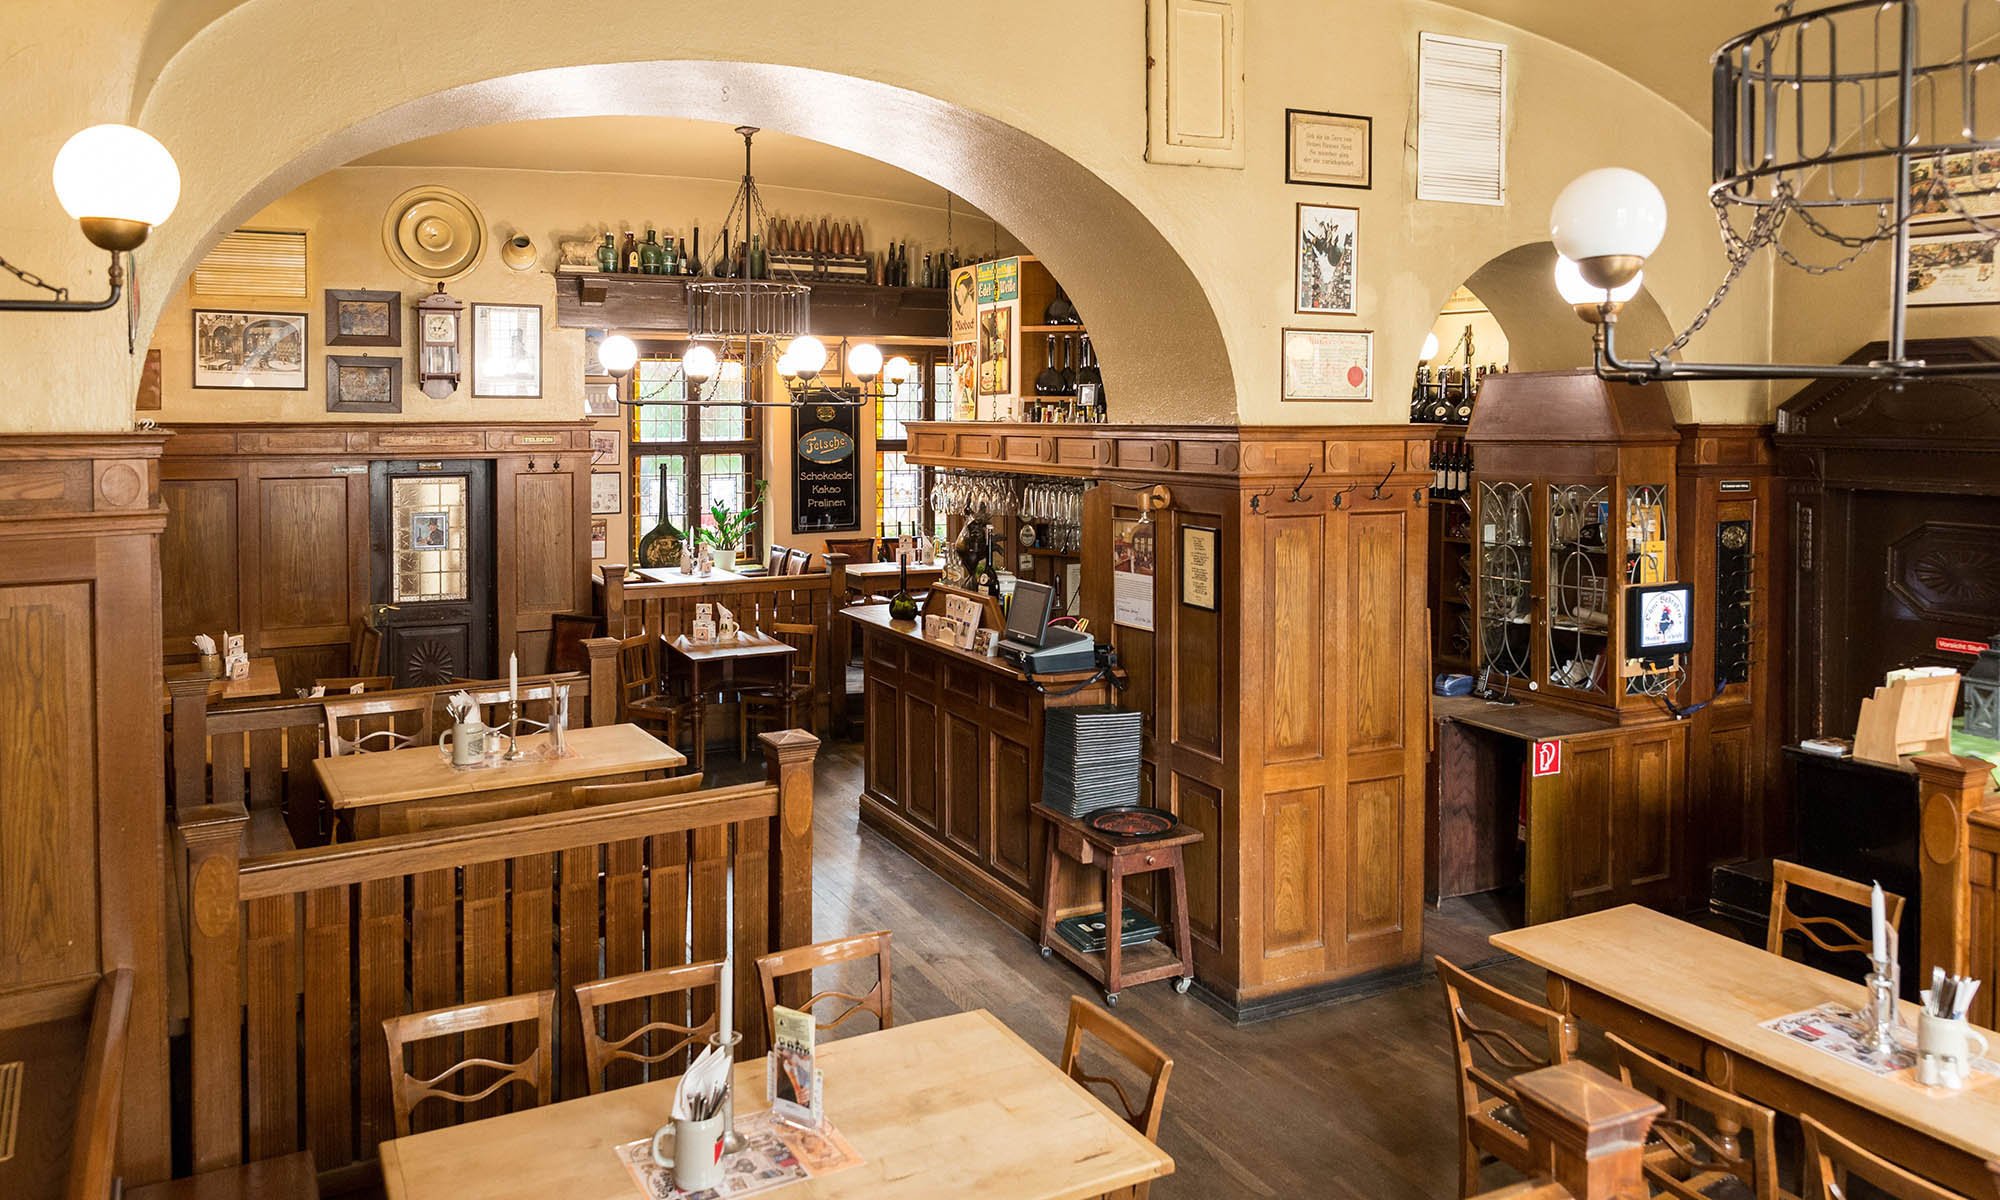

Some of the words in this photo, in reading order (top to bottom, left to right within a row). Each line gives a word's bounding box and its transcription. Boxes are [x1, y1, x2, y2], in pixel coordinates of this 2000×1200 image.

[806, 435, 846, 454] Felsche
[800, 471, 853, 481] Schokolade
[812, 484, 842, 494] Kakao
[807, 497, 846, 508] Pralinen
[1938, 640, 1967, 650] Vorsicht
